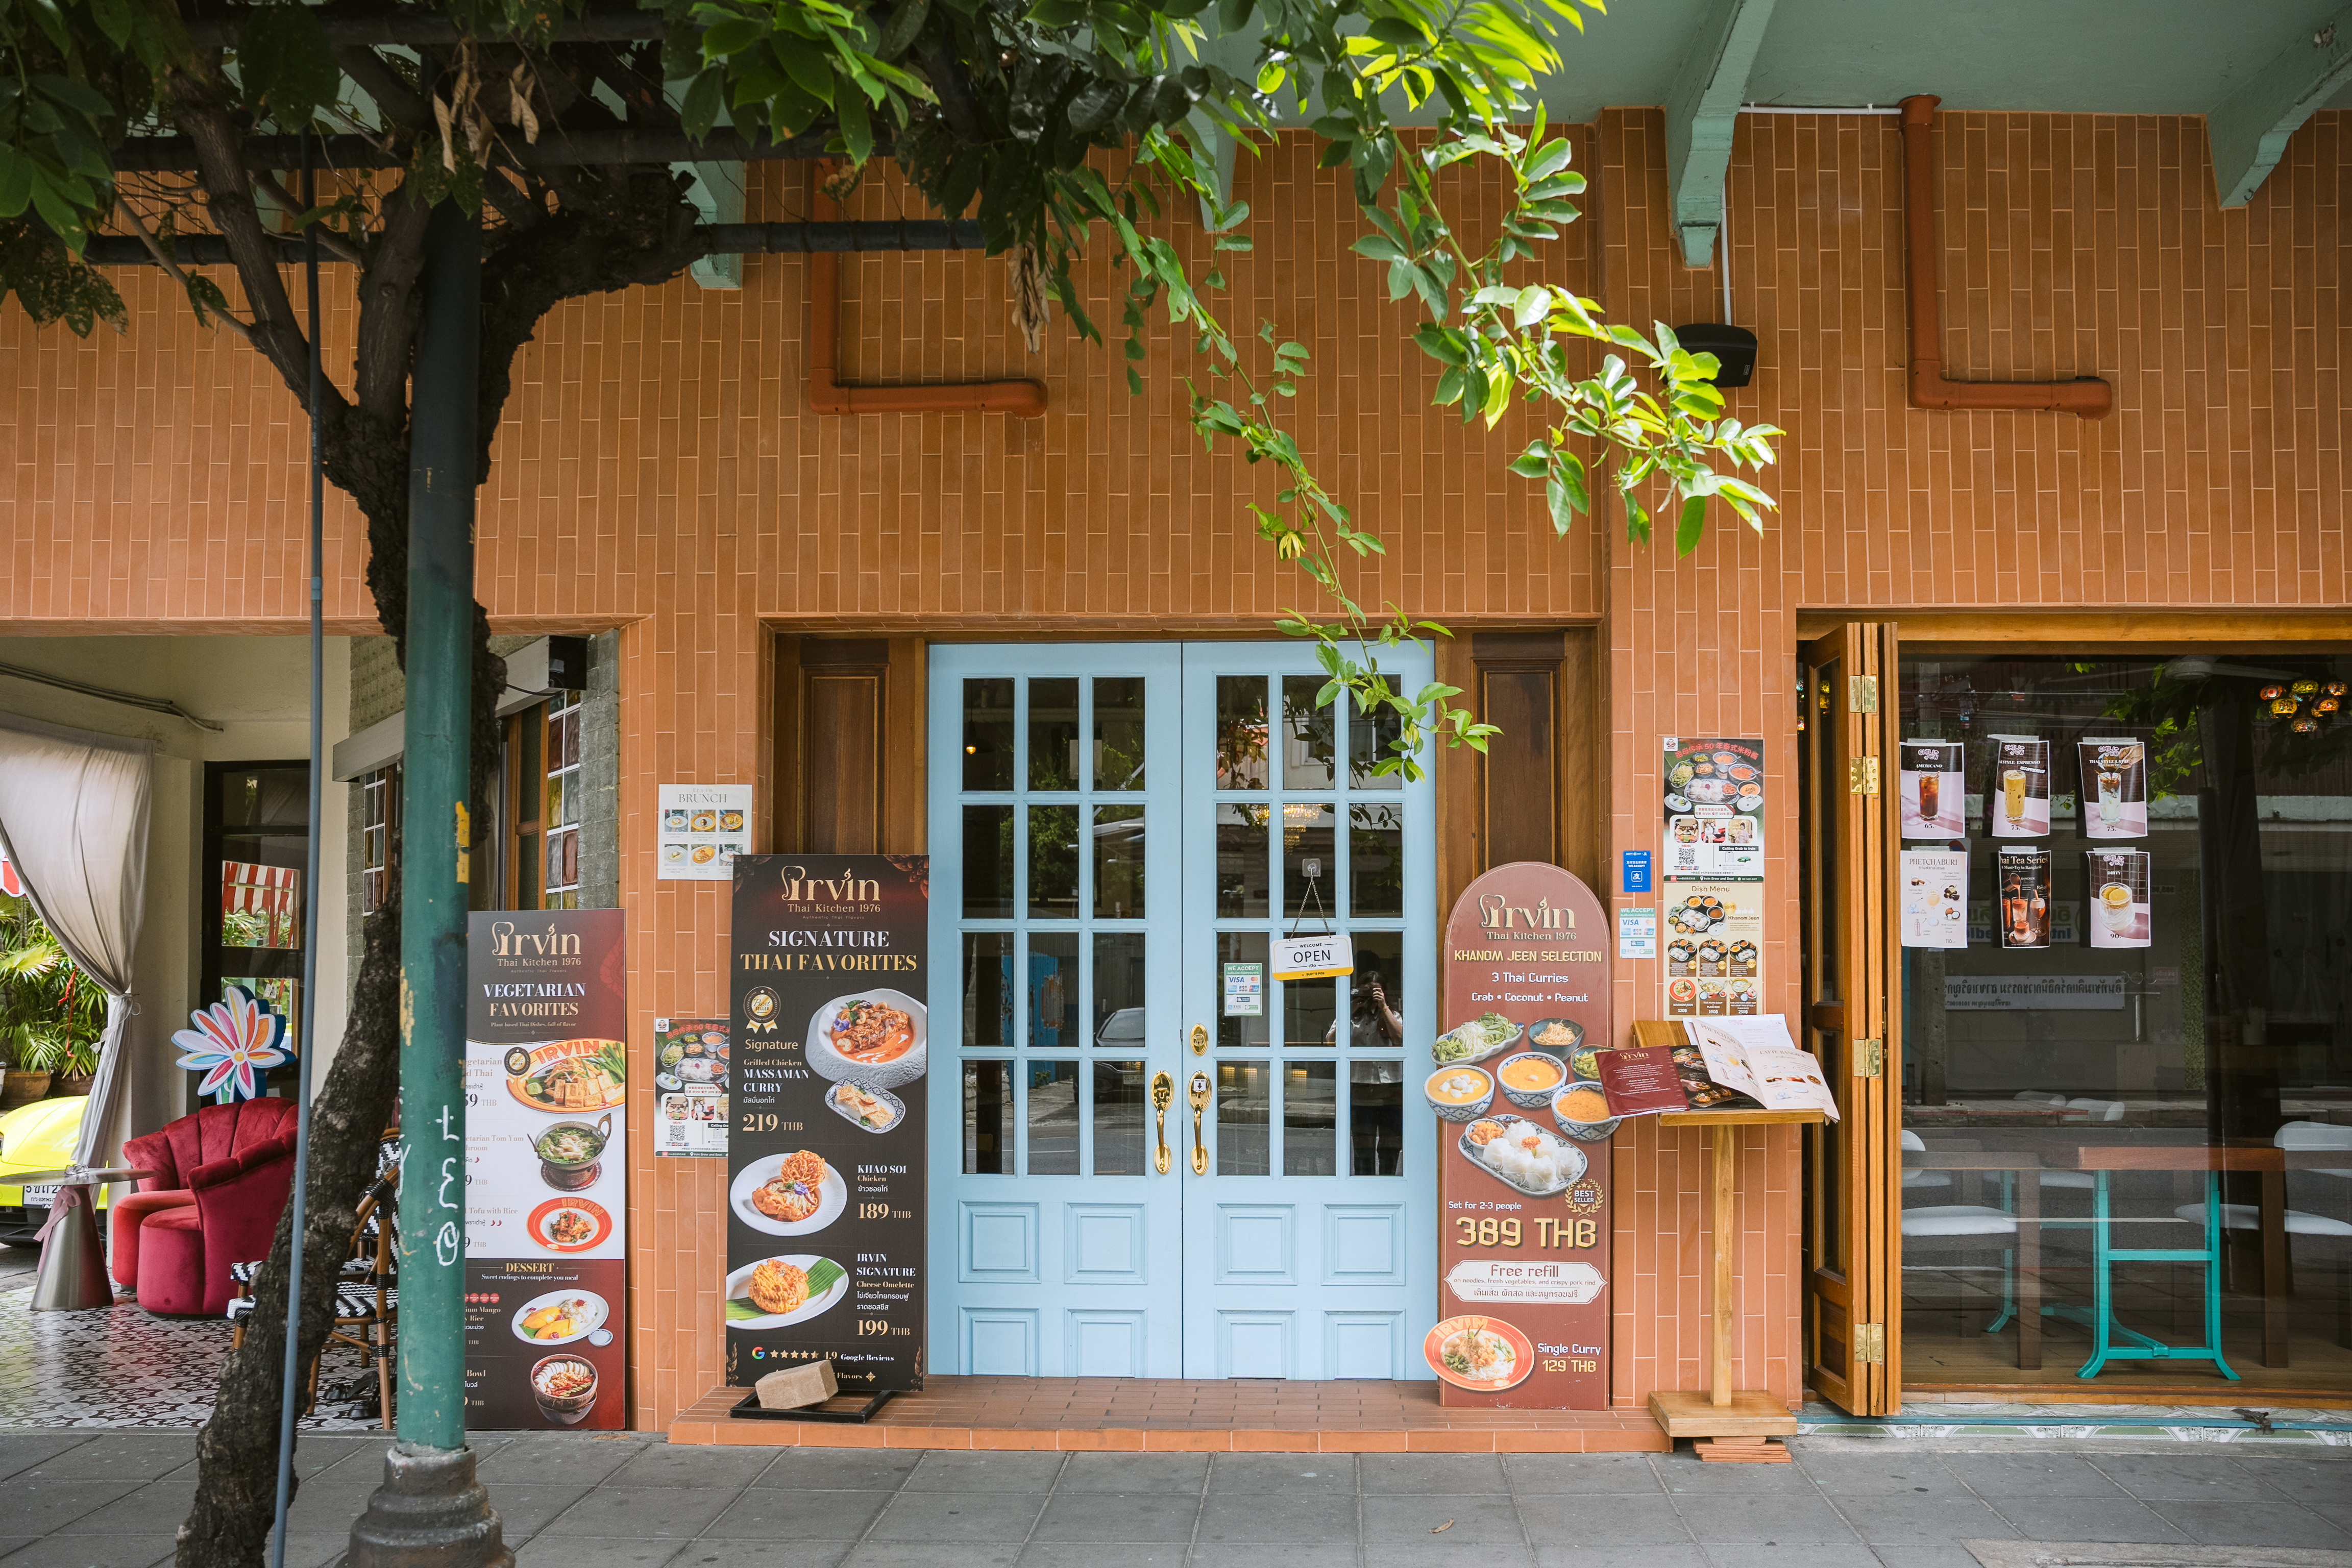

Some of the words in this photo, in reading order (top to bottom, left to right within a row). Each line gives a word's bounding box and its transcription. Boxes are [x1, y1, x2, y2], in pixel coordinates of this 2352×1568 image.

[1675, 744, 1703, 759] 祖母传承
[679, 794, 727, 802] BRUNCH
[781, 865, 880, 901] Irvin
[787, 904, 810, 912] Thai
[815, 904, 854, 912] Kitchen
[860, 904, 880, 912] 1976
[1480, 894, 1576, 928] Irvin
[492, 921, 581, 955] Irvin
[769, 930, 889, 947] SIGNATURE
[1486, 932, 1509, 940] Thai
[1513, 932, 1551, 940] Kitchen
[1556, 932, 1576, 940] 1976
[562, 958, 581, 966] 1976
[741, 954, 793, 970] THAI
[798, 954, 917, 971] FAVORITES
[1293, 950, 1330, 963] OPEN
[1454, 950, 1504, 961] KHANOM
[1507, 950, 1537, 962] JEEN
[1541, 951, 1602, 962] SELECTION
[1491, 972, 1499, 982] 3
[1503, 972, 1525, 982] Thai
[1529, 973, 1569, 983] Curries
[483, 983, 586, 997] VEGETARIAN
[1472, 992, 1493, 1001] Crab
[1505, 993, 1544, 1001] Coconut
[1555, 993, 1588, 1002] Peanut
[489, 1003, 578, 1016] FAVORITES
[536, 1040, 599, 1064] IRVIN
[745, 1039, 798, 1052] Signature
[465, 1058, 502, 1067] getarian
[744, 1069, 809, 1079] MASSAMAN
[743, 1082, 783, 1092] CURRY
[743, 1113, 778, 1132] 219
[781, 1121, 803, 1131] THB
[857, 1165, 888, 1173] KHAO
[889, 1165, 906, 1173] SOI
[561, 1198, 604, 1216] IRVIN
[857, 1203, 889, 1219] 189
[892, 1210, 911, 1219] THB
[1449, 1201, 1462, 1209] Set
[1496, 1202, 1522, 1211] people
[1456, 1217, 1521, 1246] 389
[1534, 1218, 1597, 1247] THB
[857, 1254, 887, 1262] IRVIN
[506, 1263, 554, 1272] DESSERT
[856, 1267, 916, 1277] SIGNATURE
[1491, 1264, 1522, 1277] Free
[1528, 1265, 1559, 1277] refill
[857, 1320, 888, 1336] 199
[891, 1327, 910, 1336] THB
[1433, 1317, 1488, 1339] IRVIN
[1537, 1343, 1568, 1356] Single
[1572, 1344, 1601, 1356] Curry
[823, 1351, 837, 1360] 4.9
[841, 1354, 865, 1362] Google
[1542, 1360, 1566, 1372] 129
[1571, 1360, 1597, 1373] THB
